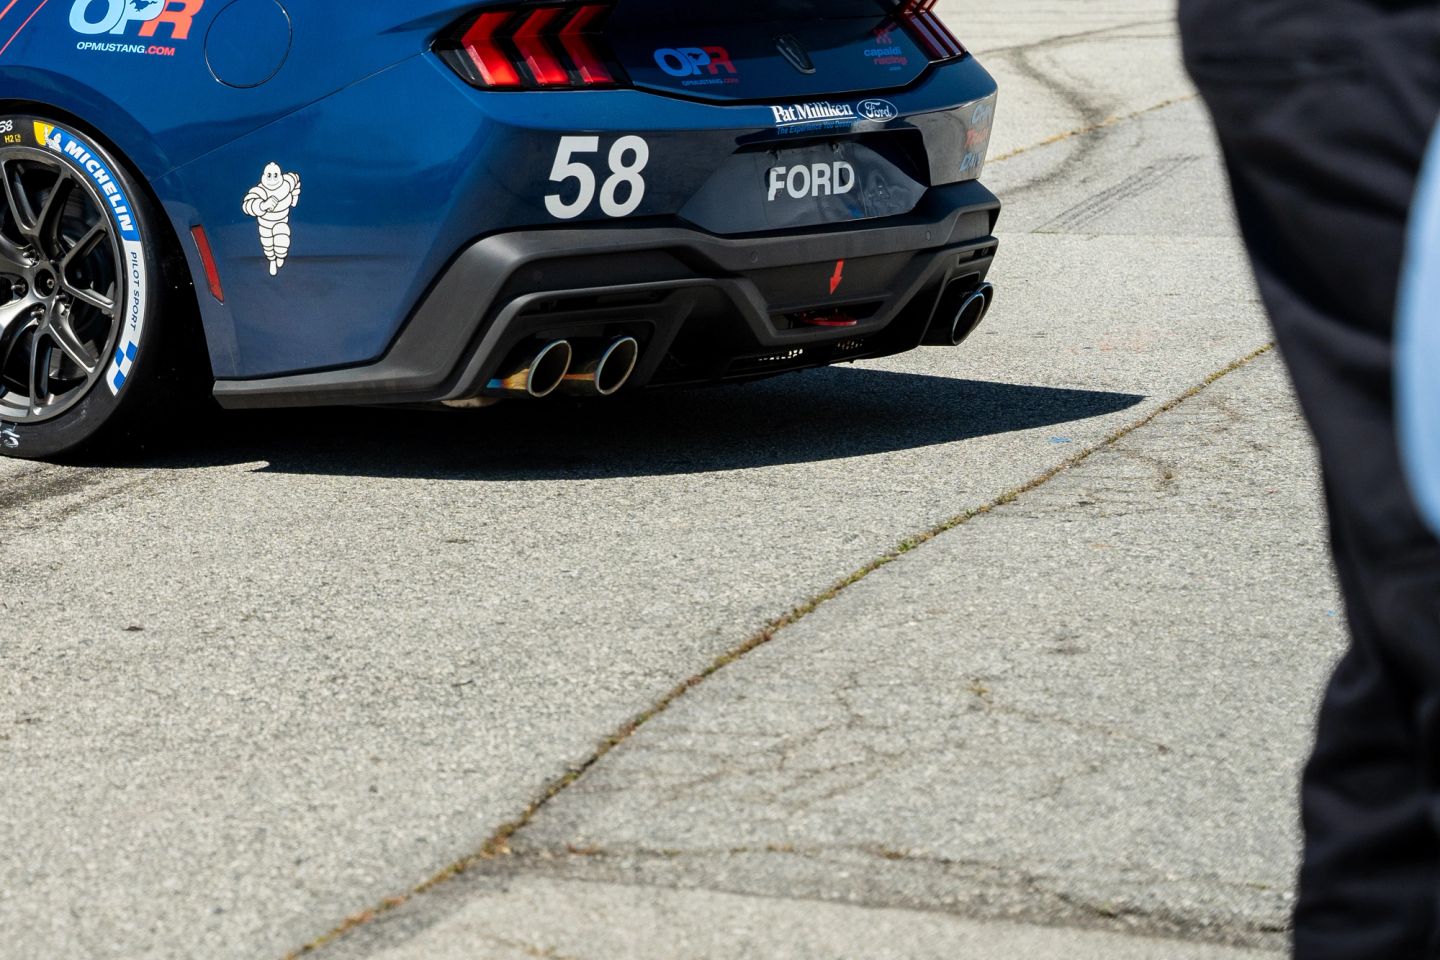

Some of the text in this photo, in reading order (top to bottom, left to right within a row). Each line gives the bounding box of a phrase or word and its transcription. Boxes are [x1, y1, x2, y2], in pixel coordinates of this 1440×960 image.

[76, 41, 176, 56] OPMUSTANG.COM
[654, 46, 737, 77] OPR
[864, 46, 902, 58] capaldi
[771, 101, 893, 122] Pat Milliken Ford
[64, 140, 134, 232] MICHELIN
[544, 135, 650, 219] 58
[768, 161, 855, 201] FORD
[131, 251, 140, 331] PILOT SPORT
